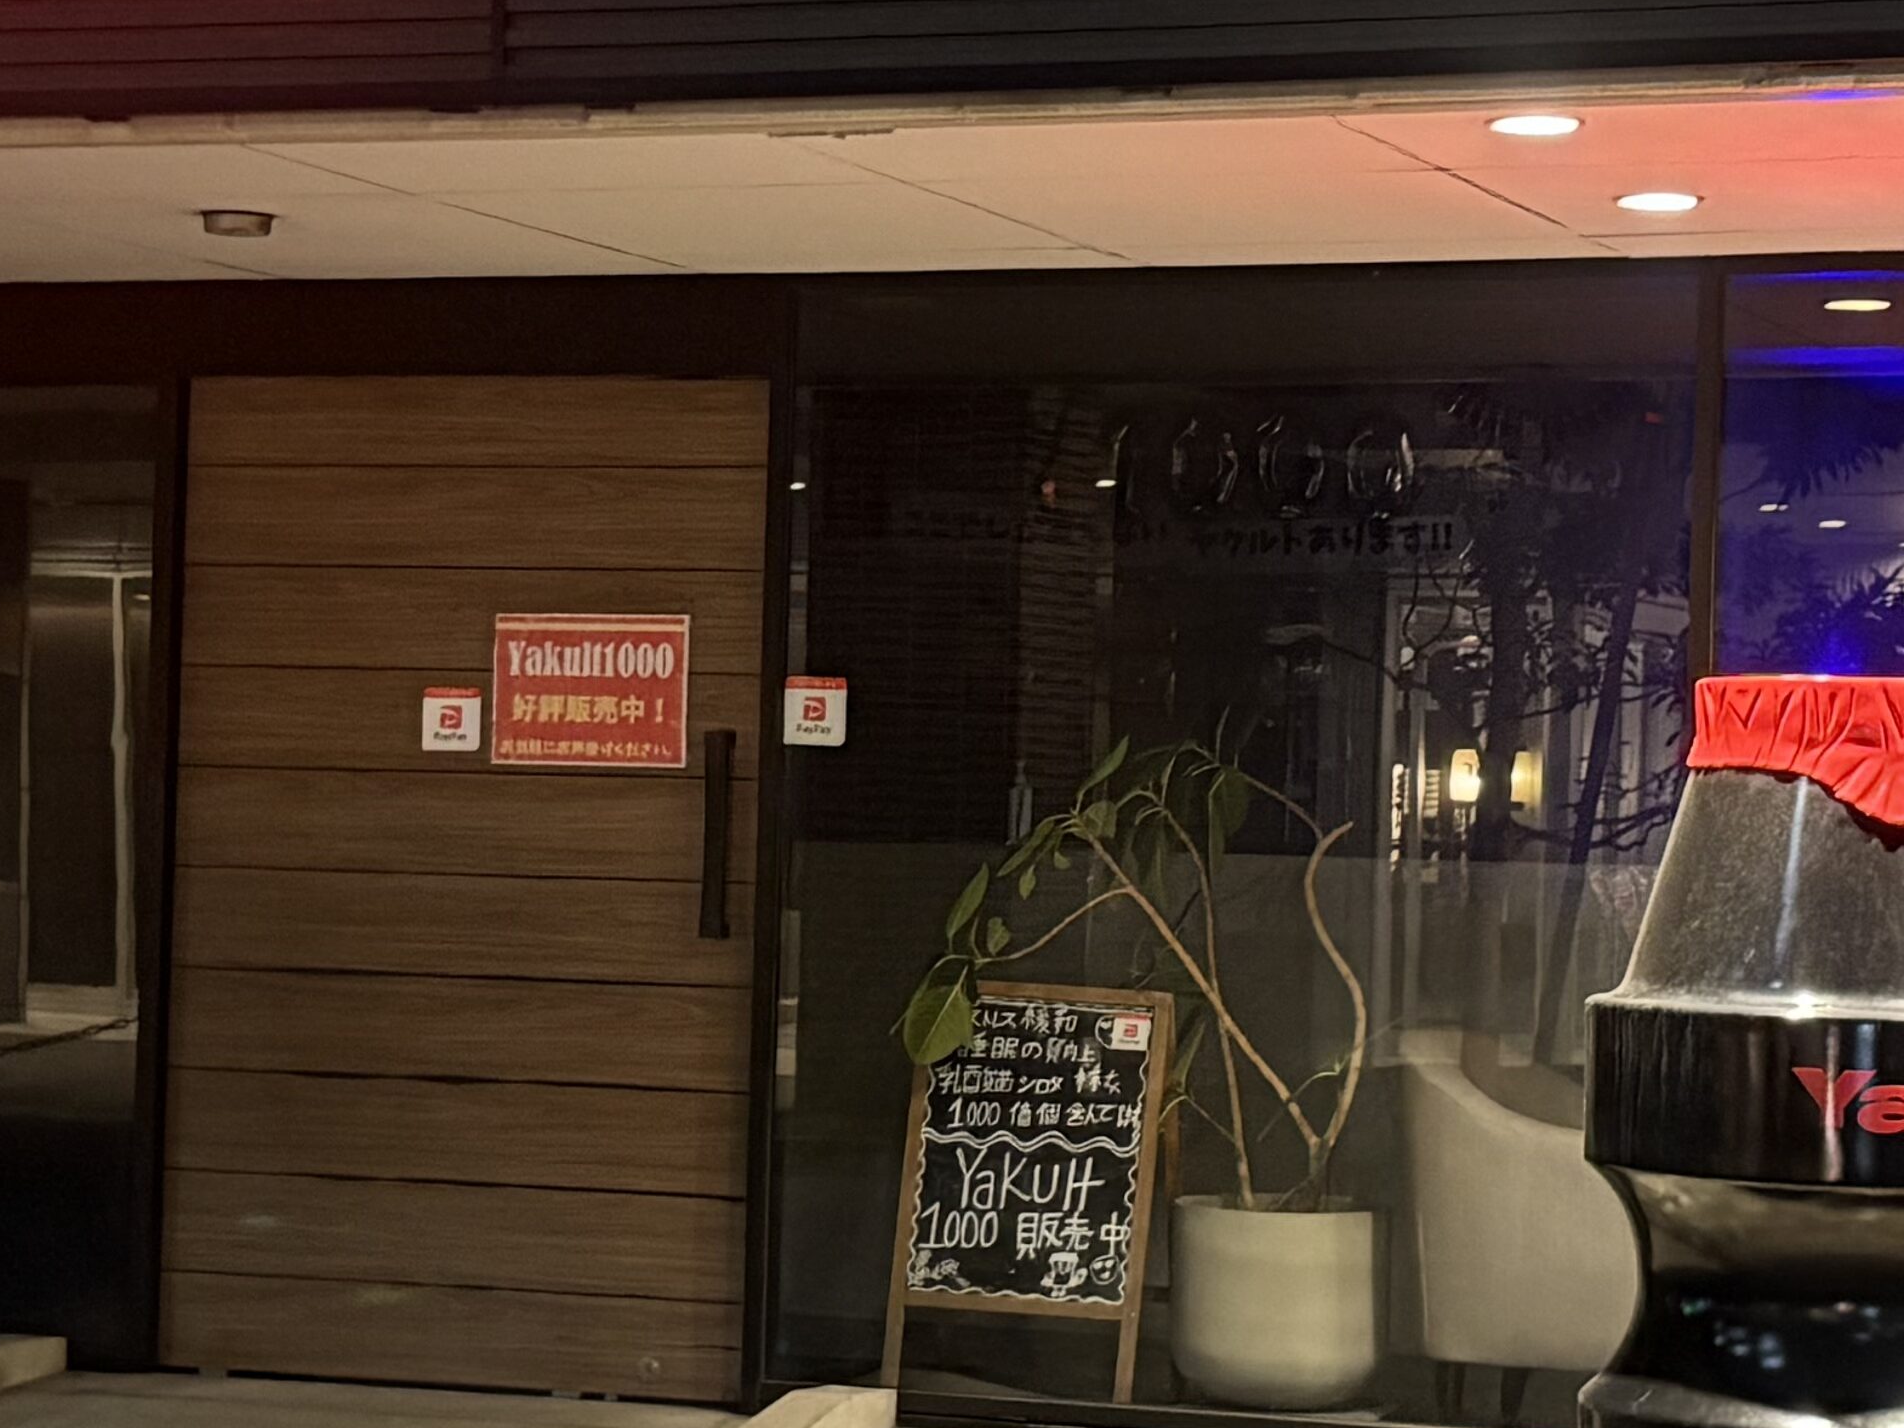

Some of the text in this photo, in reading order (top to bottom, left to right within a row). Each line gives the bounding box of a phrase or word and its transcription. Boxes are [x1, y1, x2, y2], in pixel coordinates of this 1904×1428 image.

[507, 640, 675, 679] Yakult1000
[919, 1202, 1132, 1260] 1000 販売中
